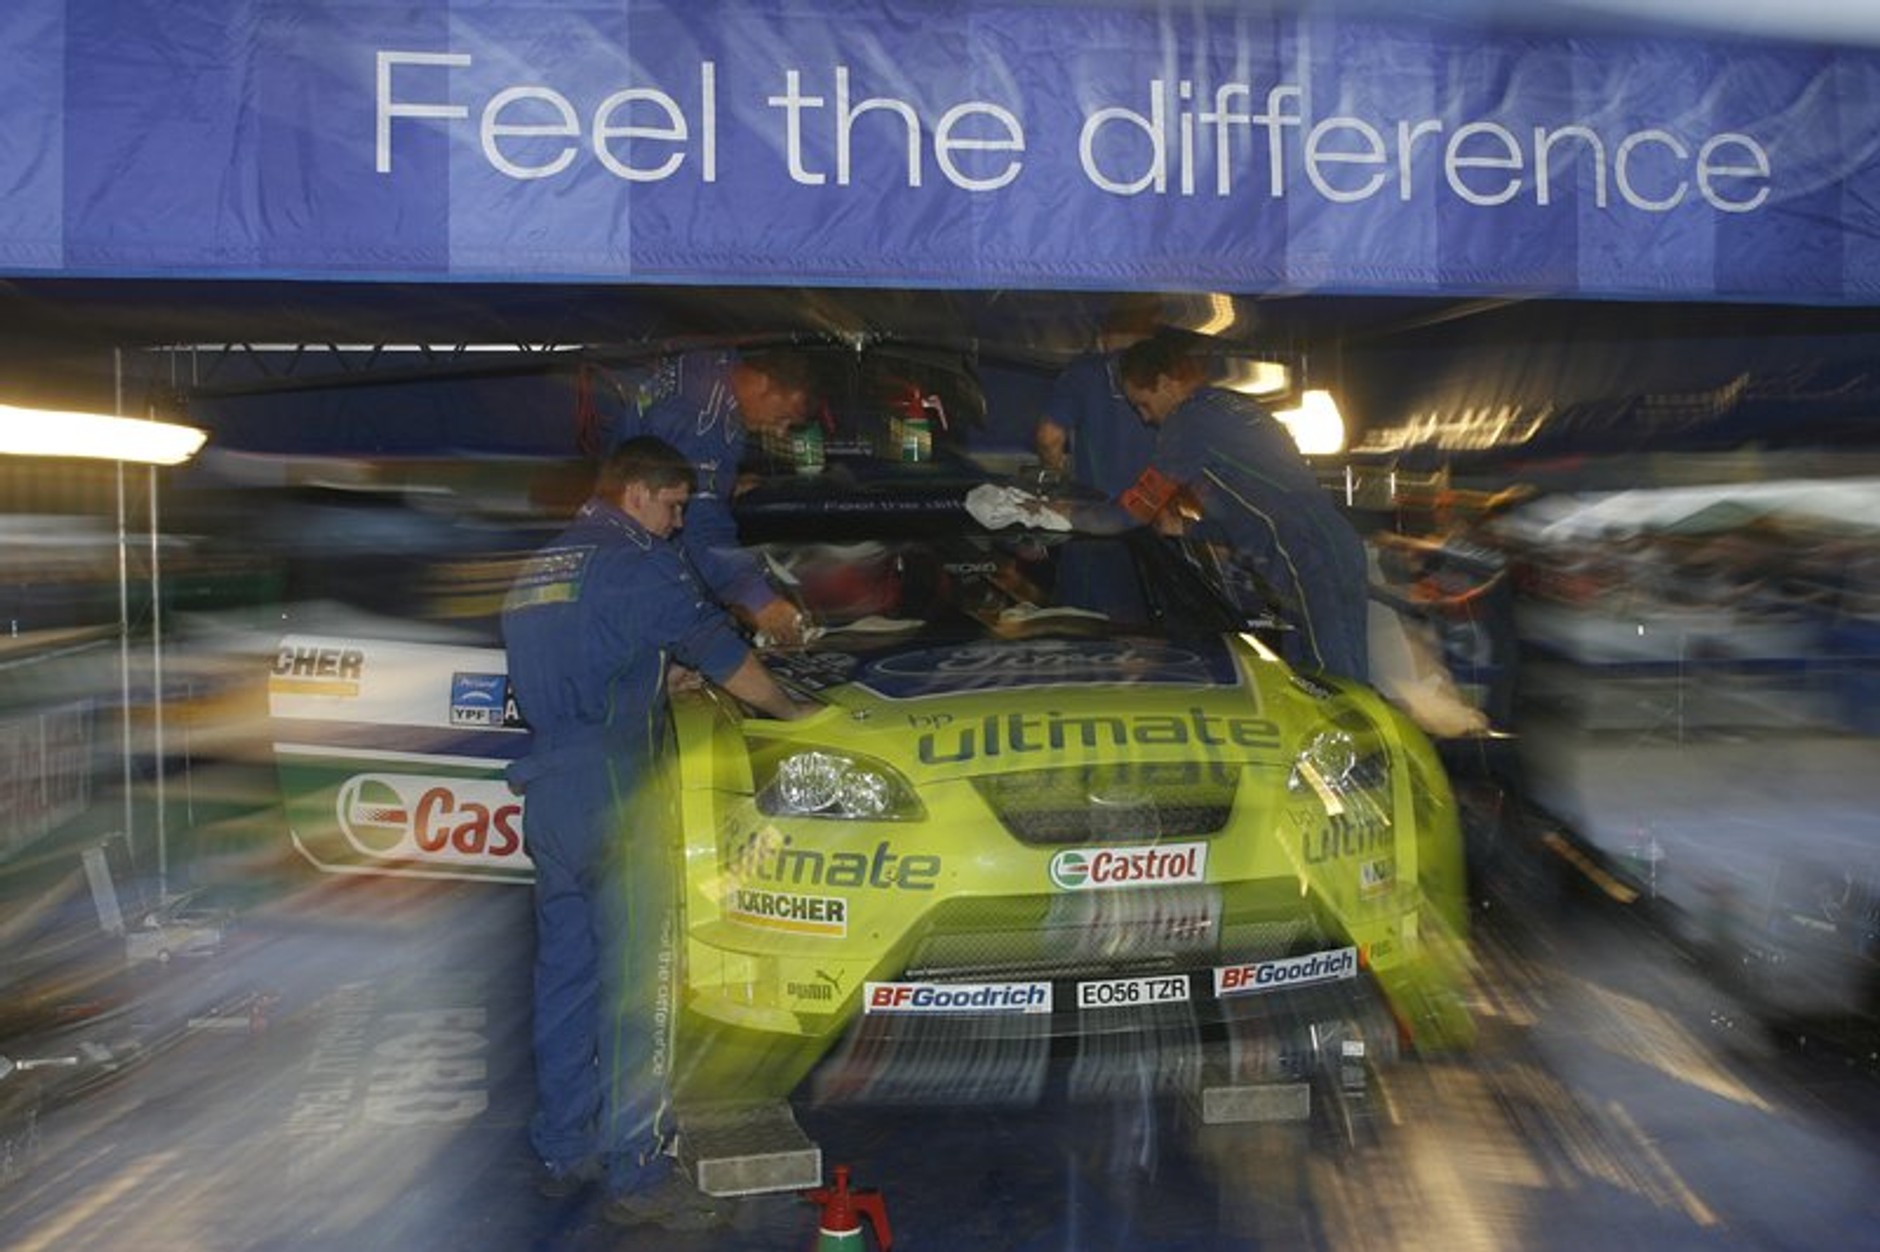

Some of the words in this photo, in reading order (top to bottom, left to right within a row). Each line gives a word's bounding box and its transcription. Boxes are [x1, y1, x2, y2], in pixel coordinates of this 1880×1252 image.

[376, 51, 716, 182] Feel
[768, 66, 1026, 192] the
[1078, 79, 1771, 213] difference
[272, 646, 364, 680] CHER
[456, 709, 486, 721] YPF
[505, 698, 519, 720] A
[907, 712, 954, 730] bp
[918, 708, 1282, 765] ultimate
[414, 787, 522, 857] Cas
[1090, 847, 1197, 883] Castrol
[1221, 951, 1353, 989] BFGoodrich
[871, 984, 1046, 1007] BFGoodrich
[1083, 981, 1139, 1004] EO56
[1145, 979, 1186, 1000] TZR
